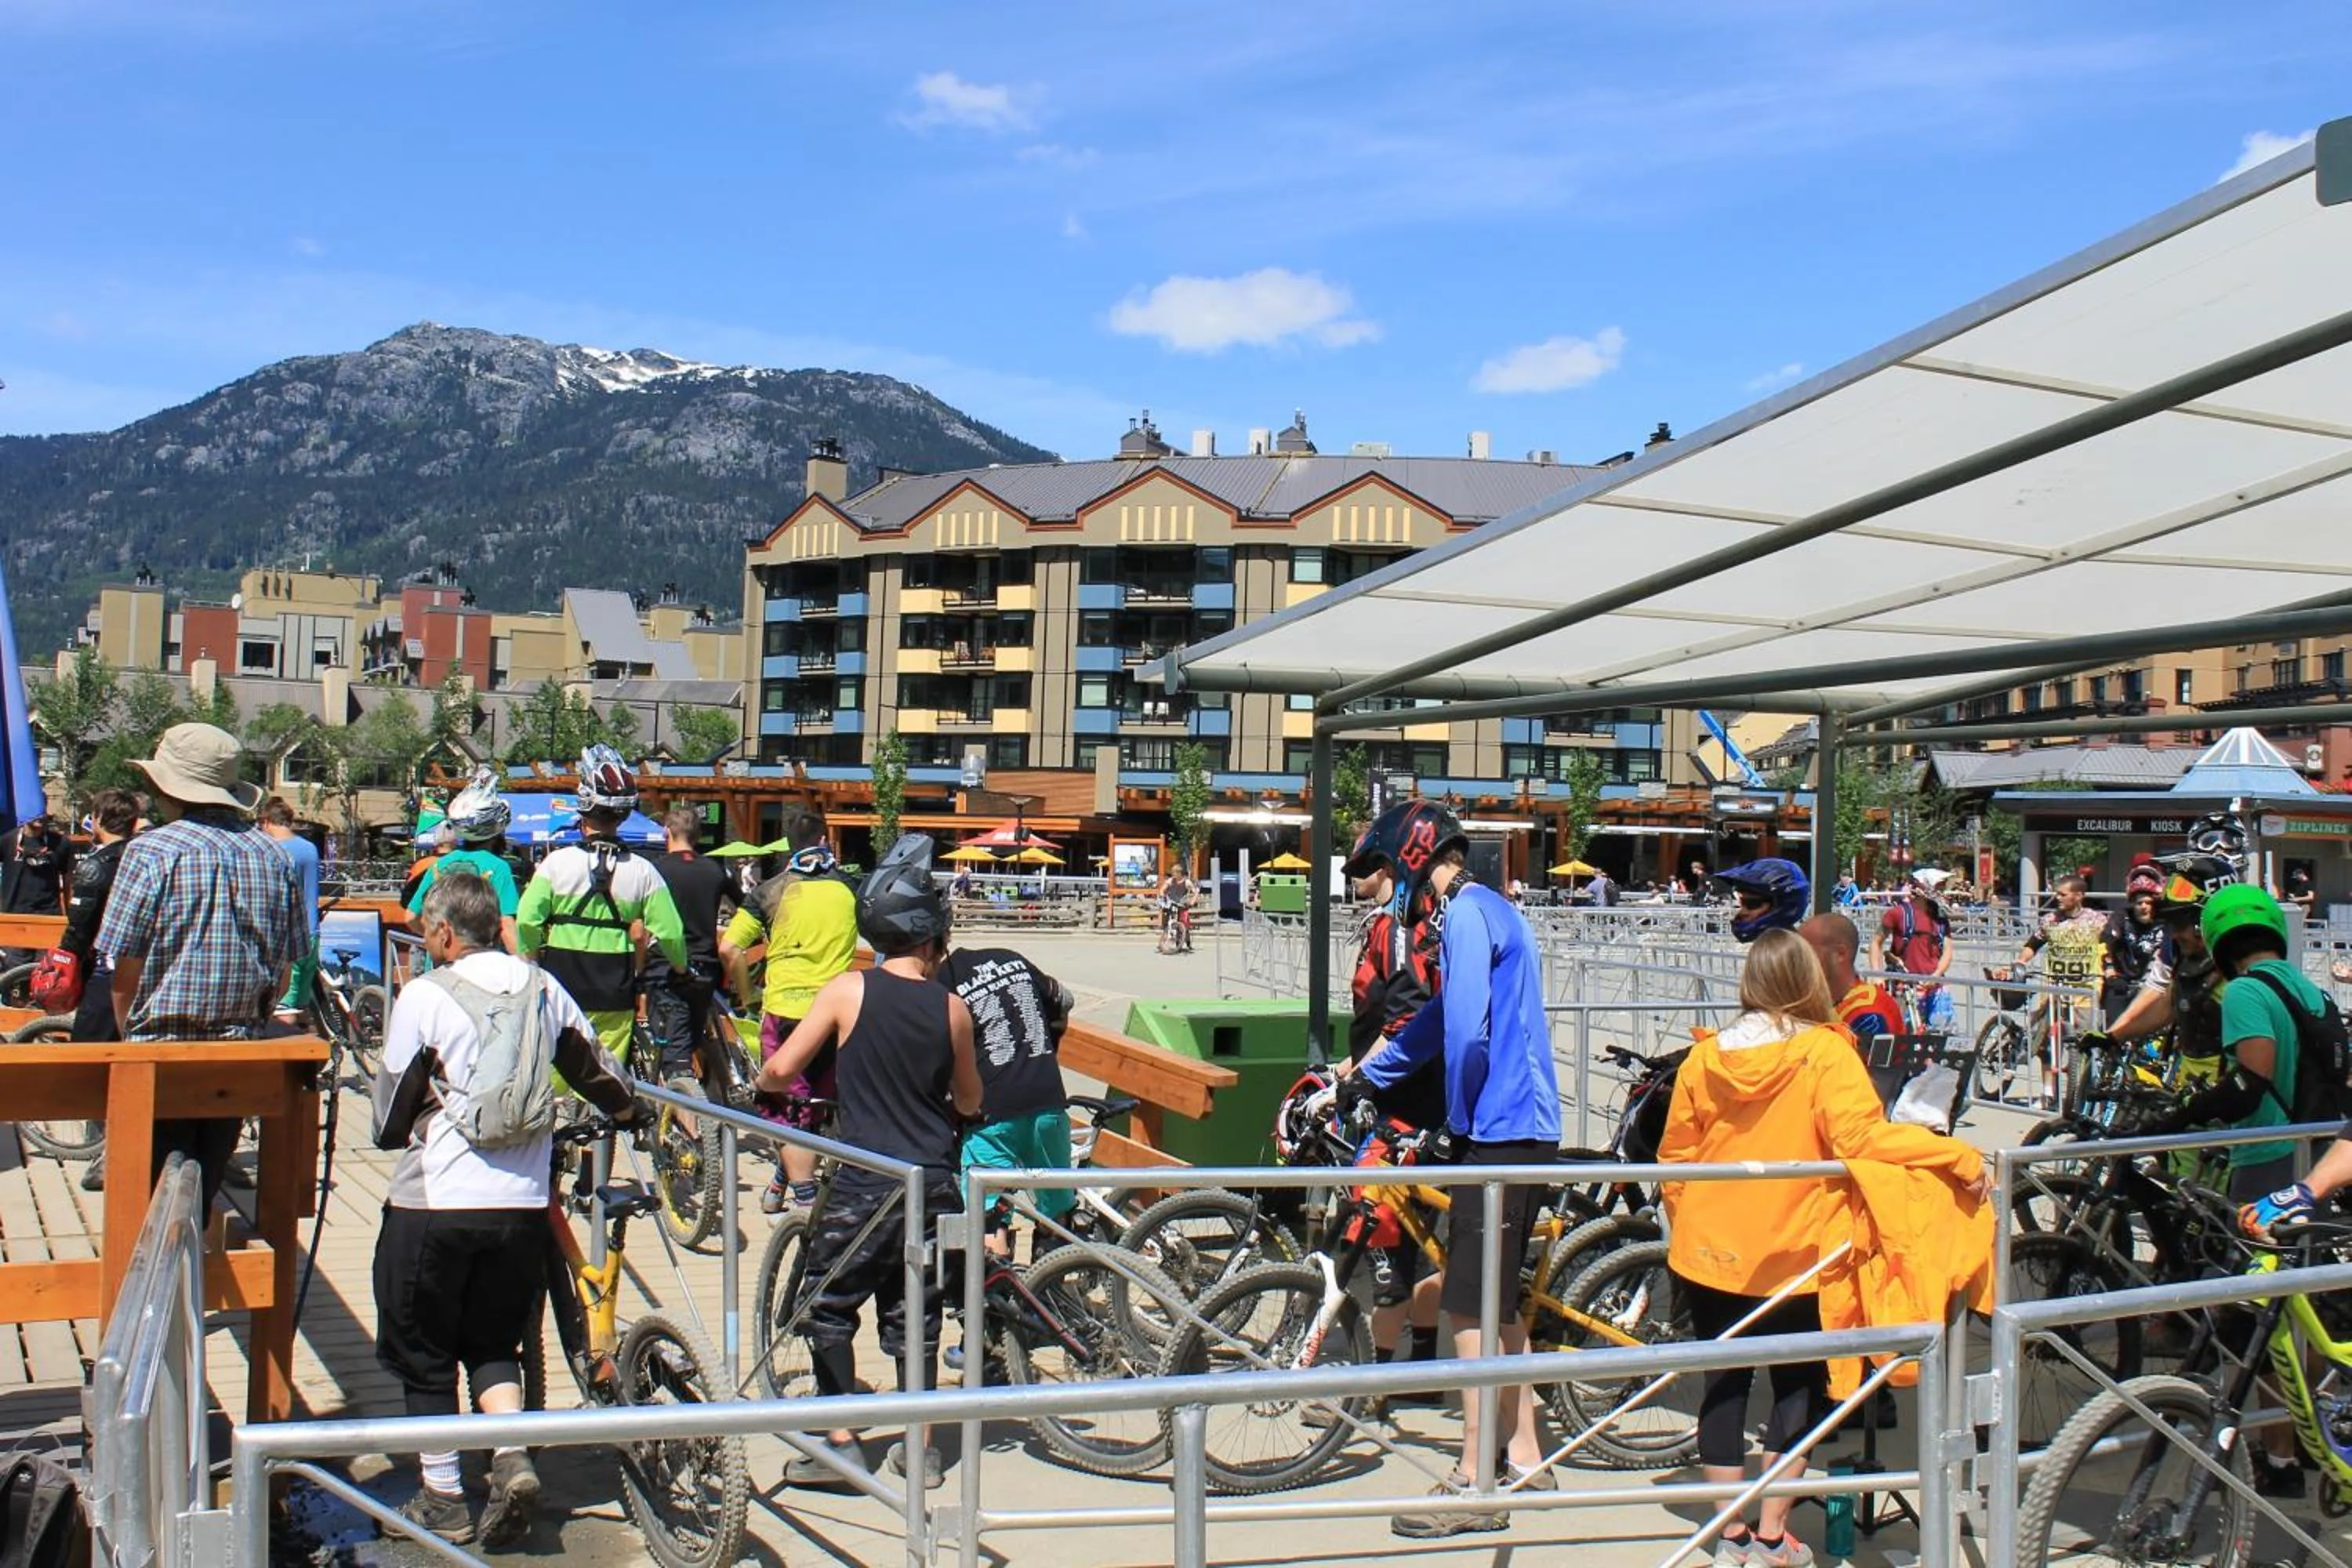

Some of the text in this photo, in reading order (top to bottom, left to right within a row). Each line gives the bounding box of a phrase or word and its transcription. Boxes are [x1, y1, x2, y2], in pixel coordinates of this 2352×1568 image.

[2077, 819, 2182, 832] EXCALIBUR KIOSK
[2288, 821, 2347, 833] ZIPLINES
[973, 960, 998, 975] THE
[956, 973, 997, 996] BLACK
[964, 986, 989, 1006] TURN
[987, 978, 1011, 992] BLUE
